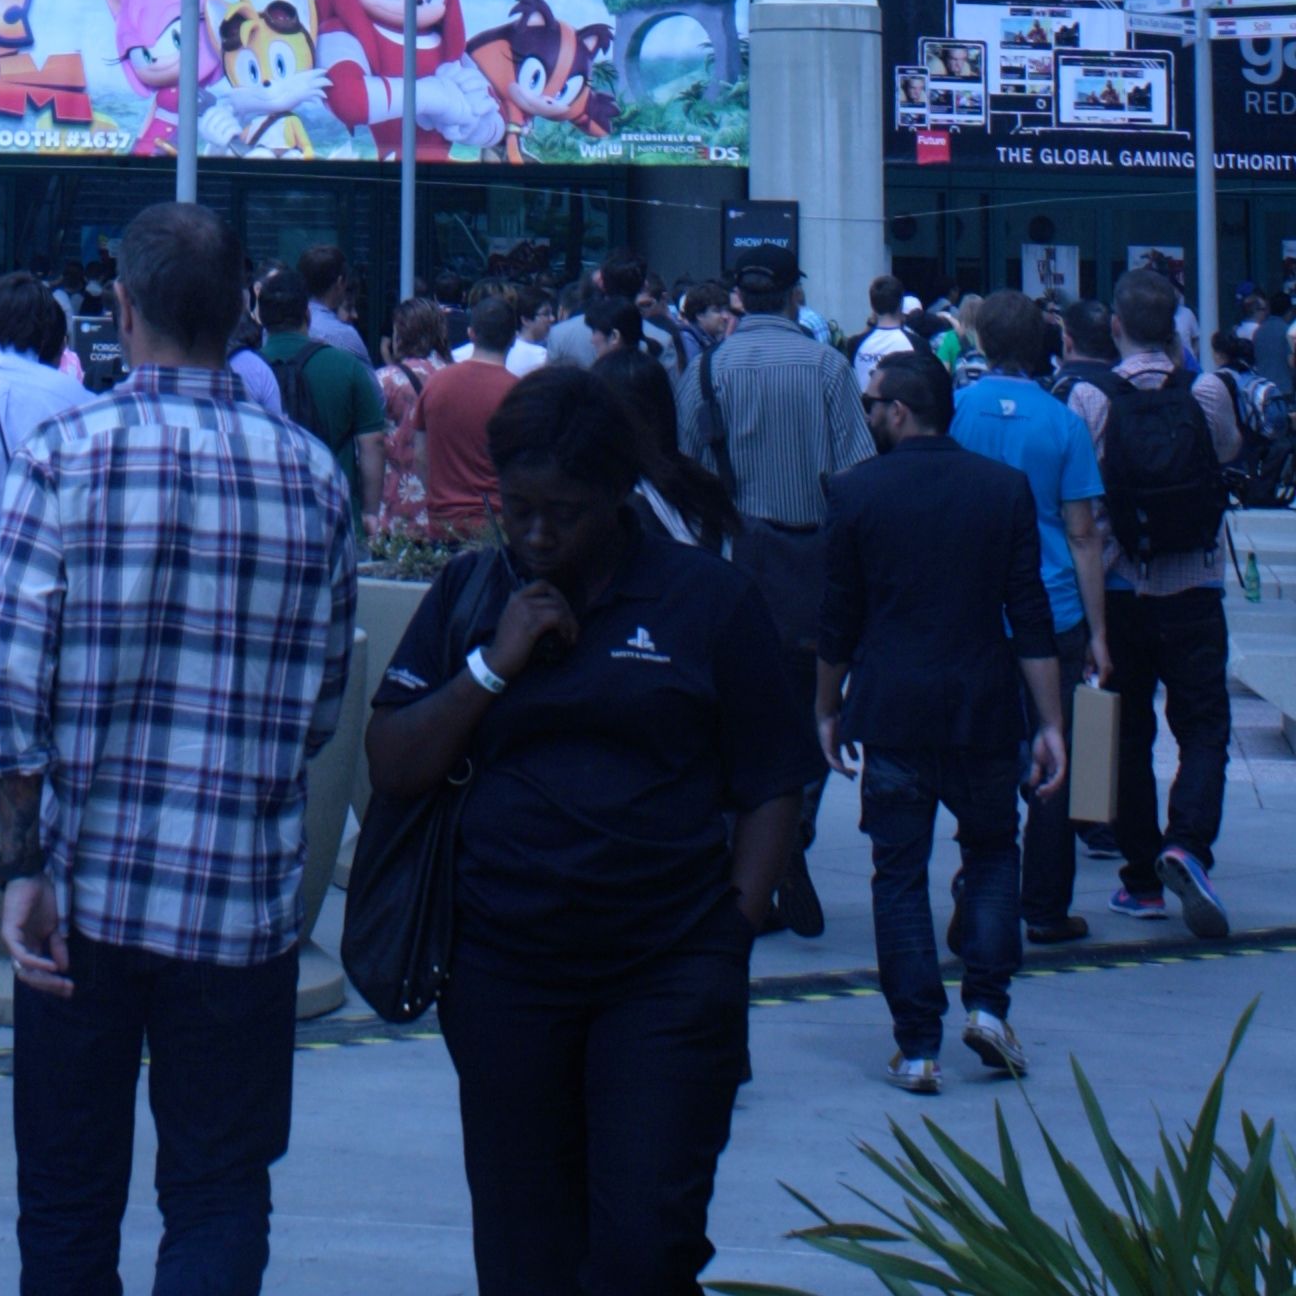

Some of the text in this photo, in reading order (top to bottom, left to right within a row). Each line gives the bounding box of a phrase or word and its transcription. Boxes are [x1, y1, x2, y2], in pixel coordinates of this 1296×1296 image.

[65, 130, 132, 150] #1637
[620, 132, 702, 143] EXCLUSIVELY ON
[917, 135, 946, 146] Future
[637, 144, 696, 154] NINTENDO
[996, 146, 1296, 172] THE GLOBAL GAMING UTHORIT
[733, 237, 763, 247] SHOW
